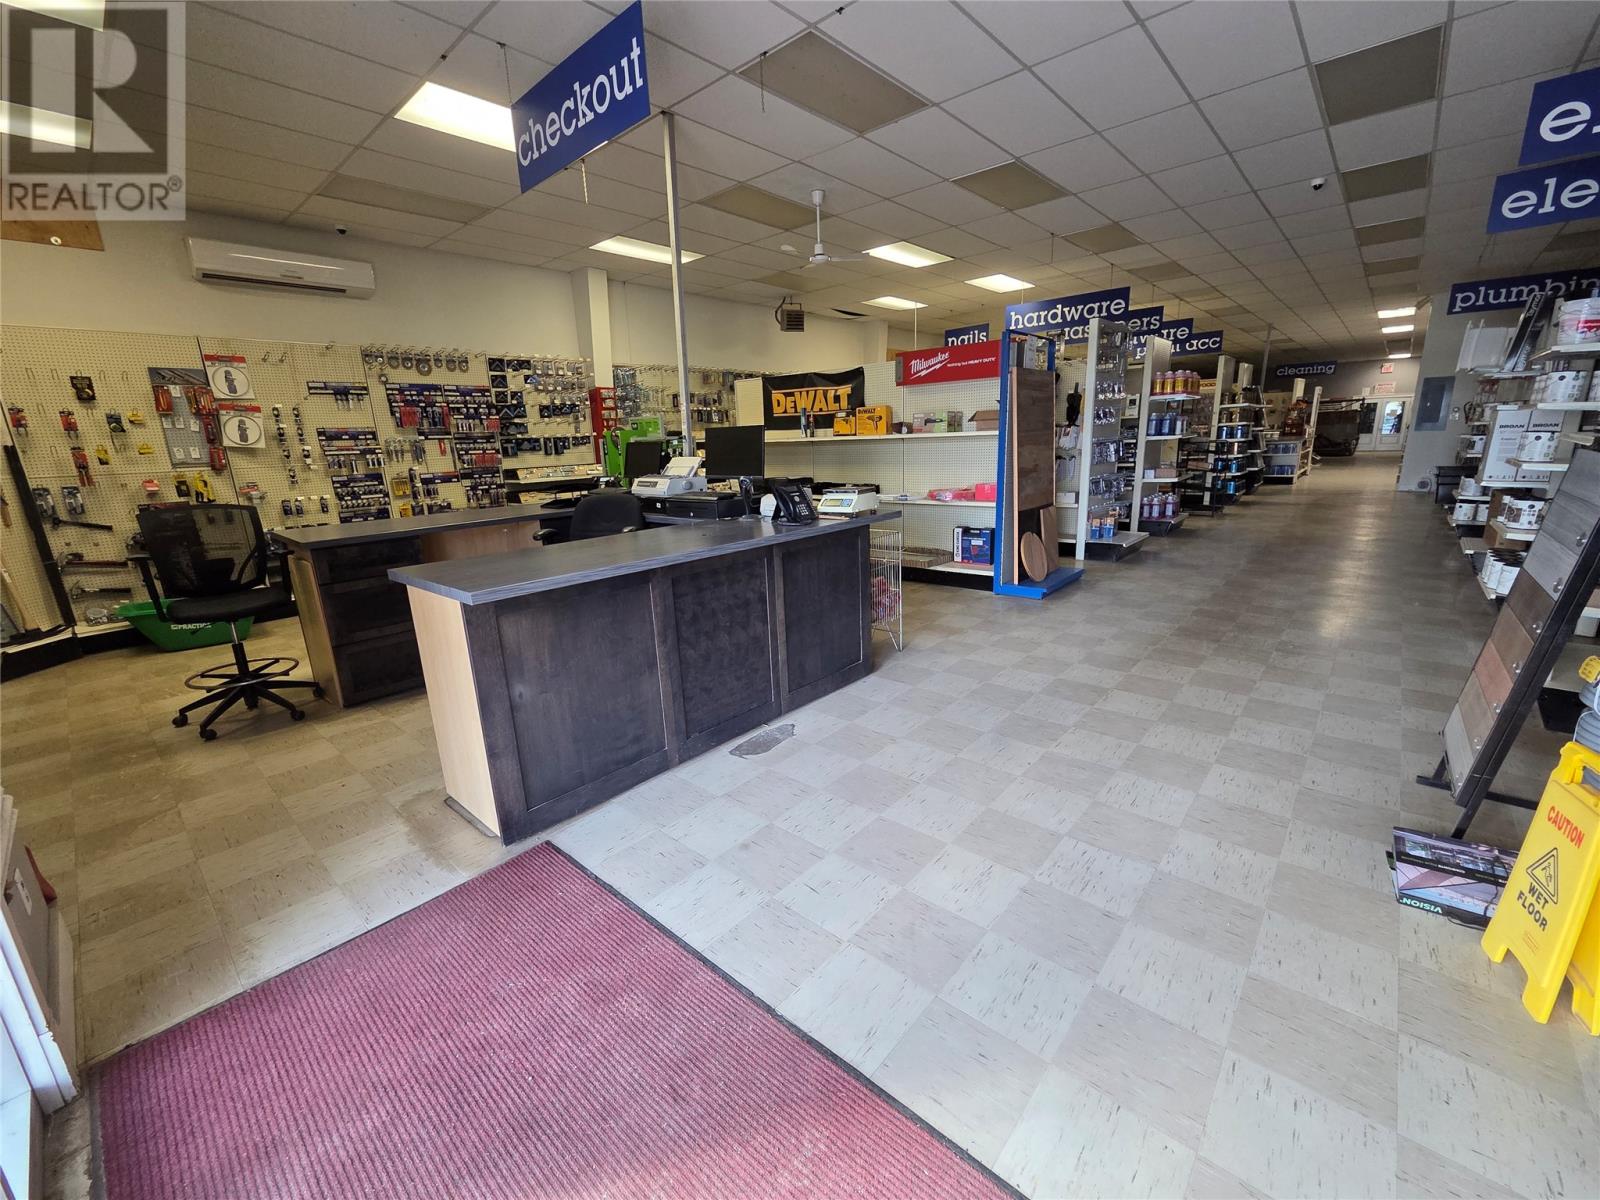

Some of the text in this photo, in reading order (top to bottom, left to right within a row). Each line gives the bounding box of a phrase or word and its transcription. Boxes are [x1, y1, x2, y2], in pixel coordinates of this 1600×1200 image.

[518, 36, 644, 167] checkout
[1009, 299, 1126, 329] hardware
[947, 330, 987, 347] nails
[1185, 337, 1220, 351] acc
[908, 352, 950, 374] Milwaukee
[1276, 363, 1335, 376] cleaning
[1548, 805, 1585, 849] CAUTION
[1401, 897, 1443, 914] VISION
[1528, 881, 1550, 910] WET
[1516, 890, 1548, 932] FLOOR
